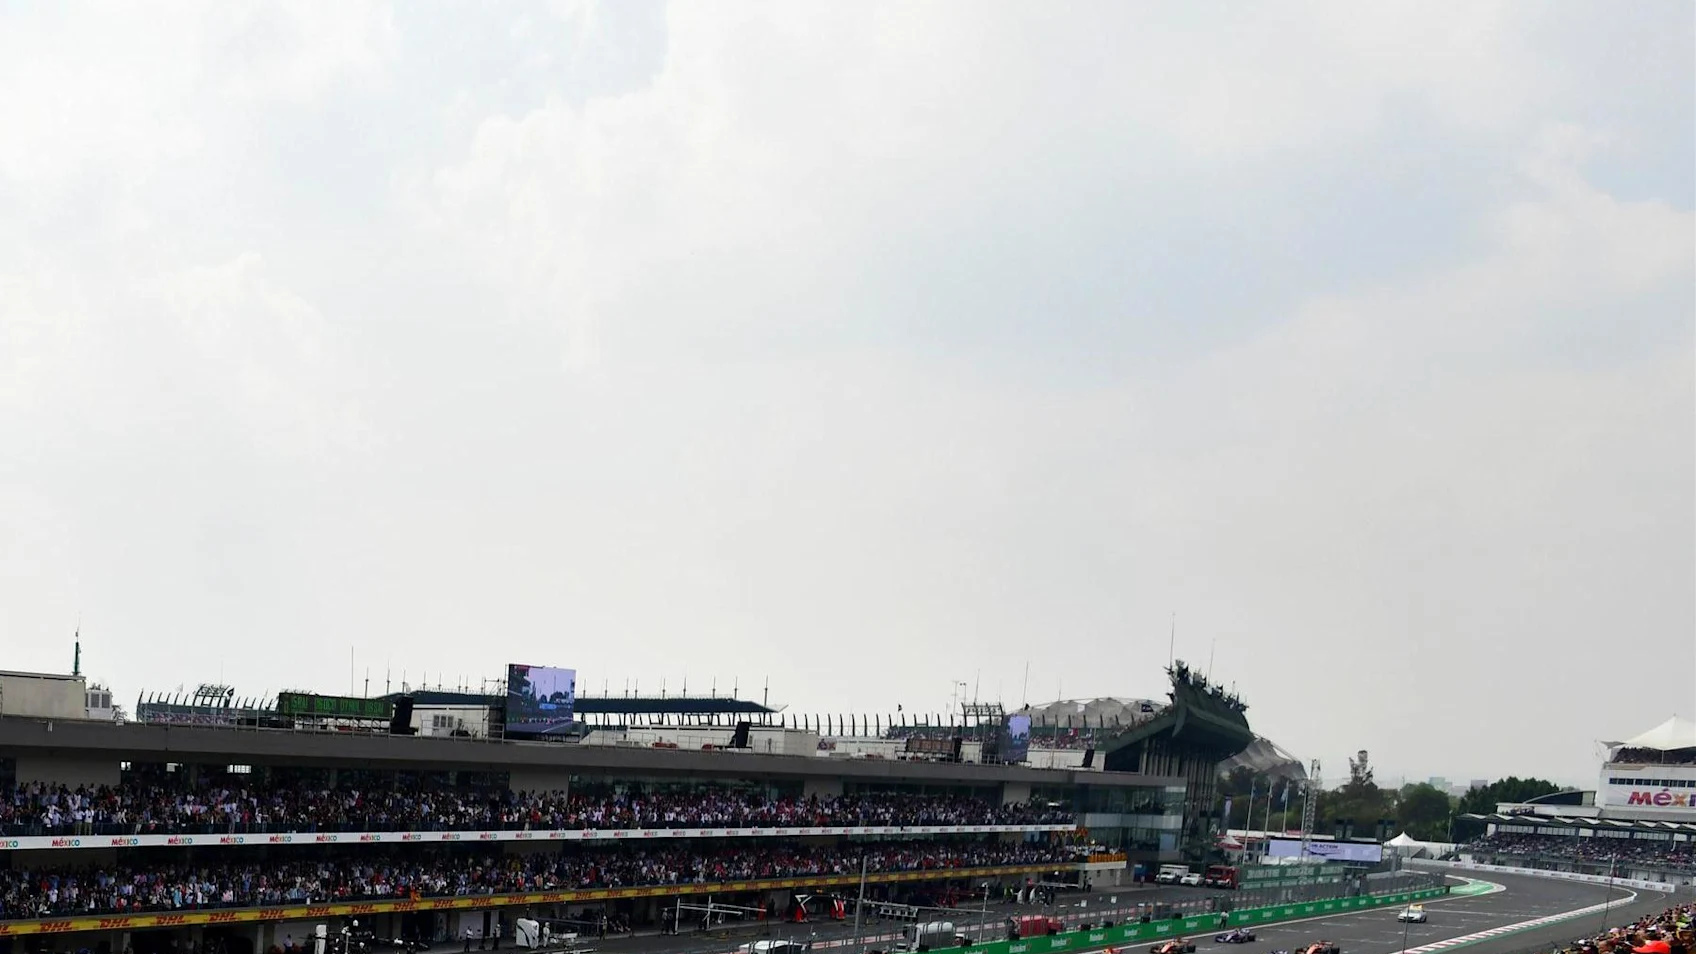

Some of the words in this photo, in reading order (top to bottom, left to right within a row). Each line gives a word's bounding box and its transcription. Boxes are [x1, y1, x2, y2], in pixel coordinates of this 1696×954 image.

[156, 915, 185, 923] DHL
[209, 913, 235, 921] DHL
[40, 921, 72, 931] DHL
[100, 918, 130, 927] DHL
